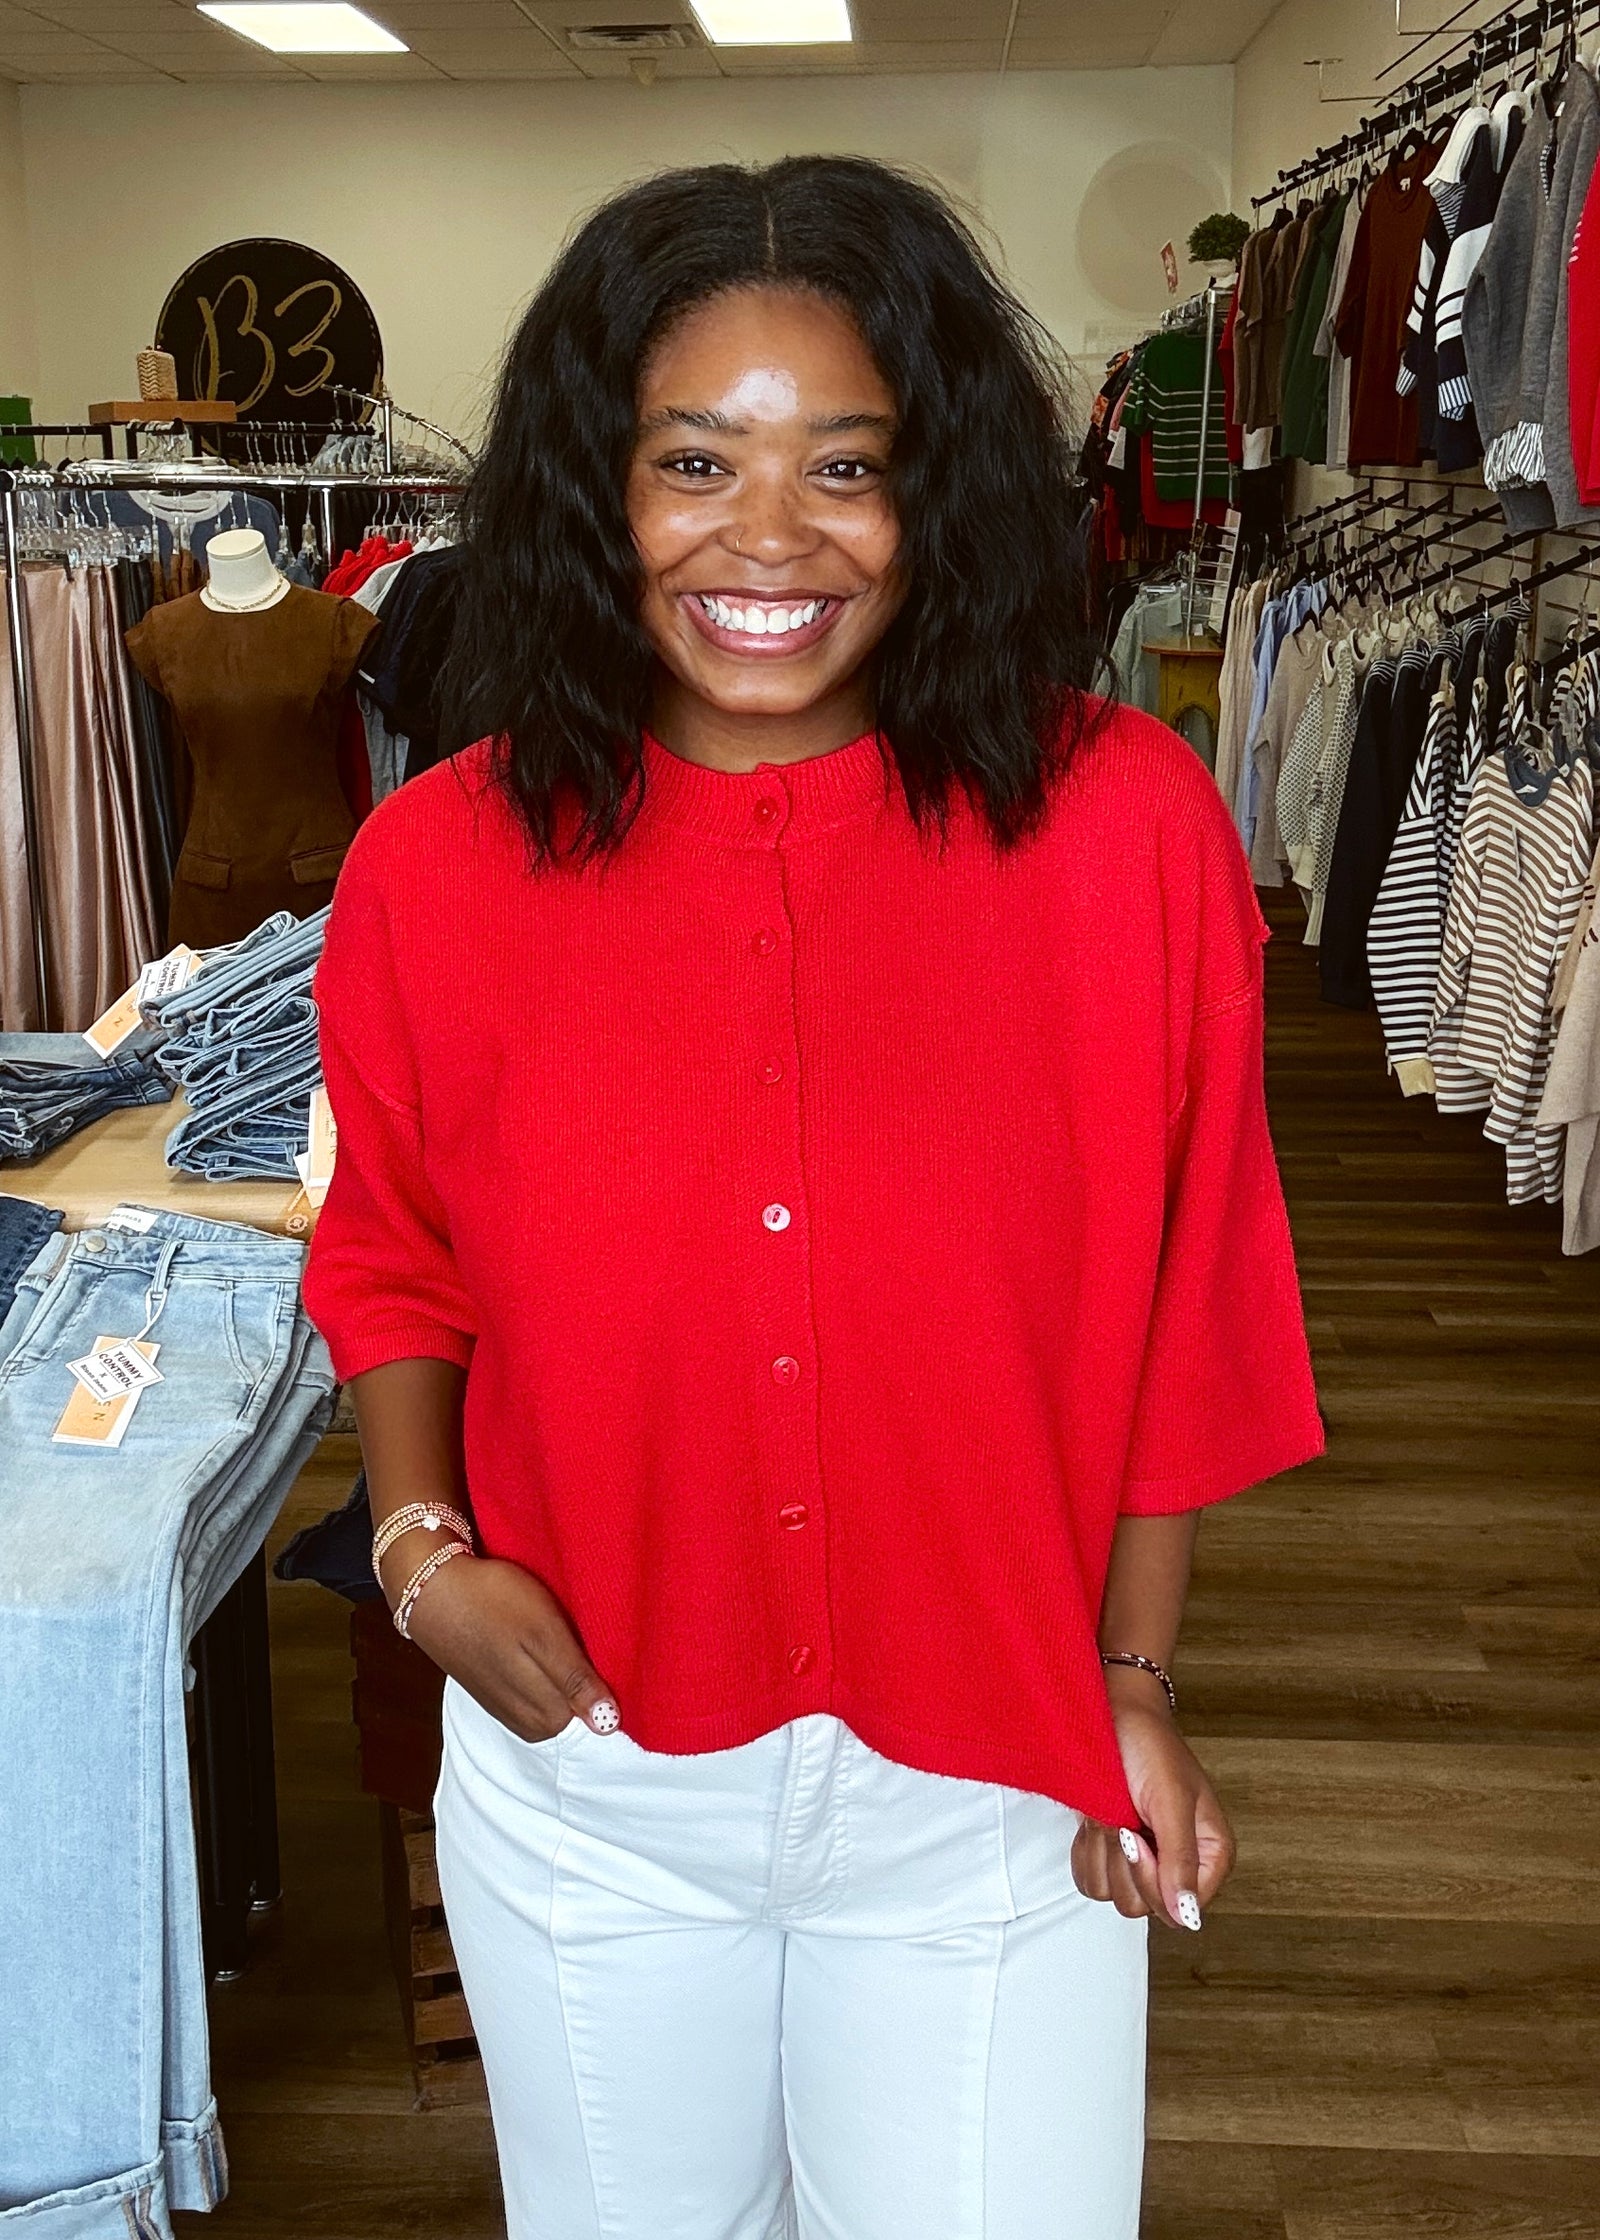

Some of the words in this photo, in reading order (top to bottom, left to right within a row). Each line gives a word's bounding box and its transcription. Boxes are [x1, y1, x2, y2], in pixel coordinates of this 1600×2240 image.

[193, 274, 342, 413] B3
[165, 961, 181, 992] TUMMY
[98, 1353, 134, 1388] CONTROL
[114, 1351, 144, 1380] TUMMY
